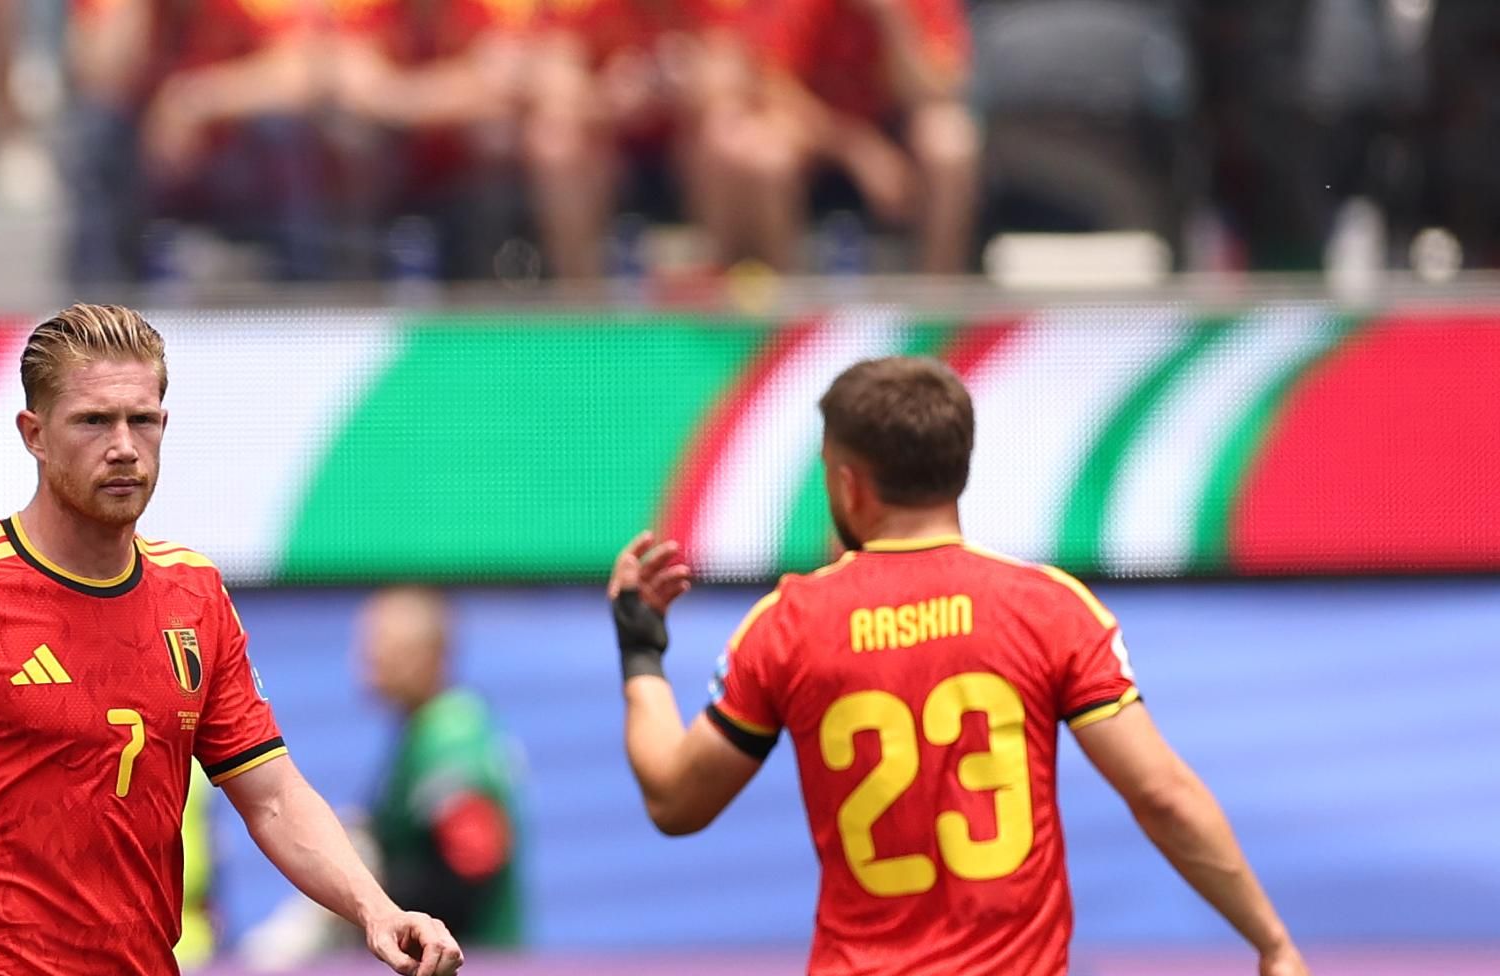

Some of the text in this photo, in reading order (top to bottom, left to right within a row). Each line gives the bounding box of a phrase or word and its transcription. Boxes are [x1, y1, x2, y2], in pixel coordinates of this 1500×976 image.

[850, 594, 973, 654] RASKIN
[107, 708, 145, 798] 7
[819, 671, 1035, 897] 23
